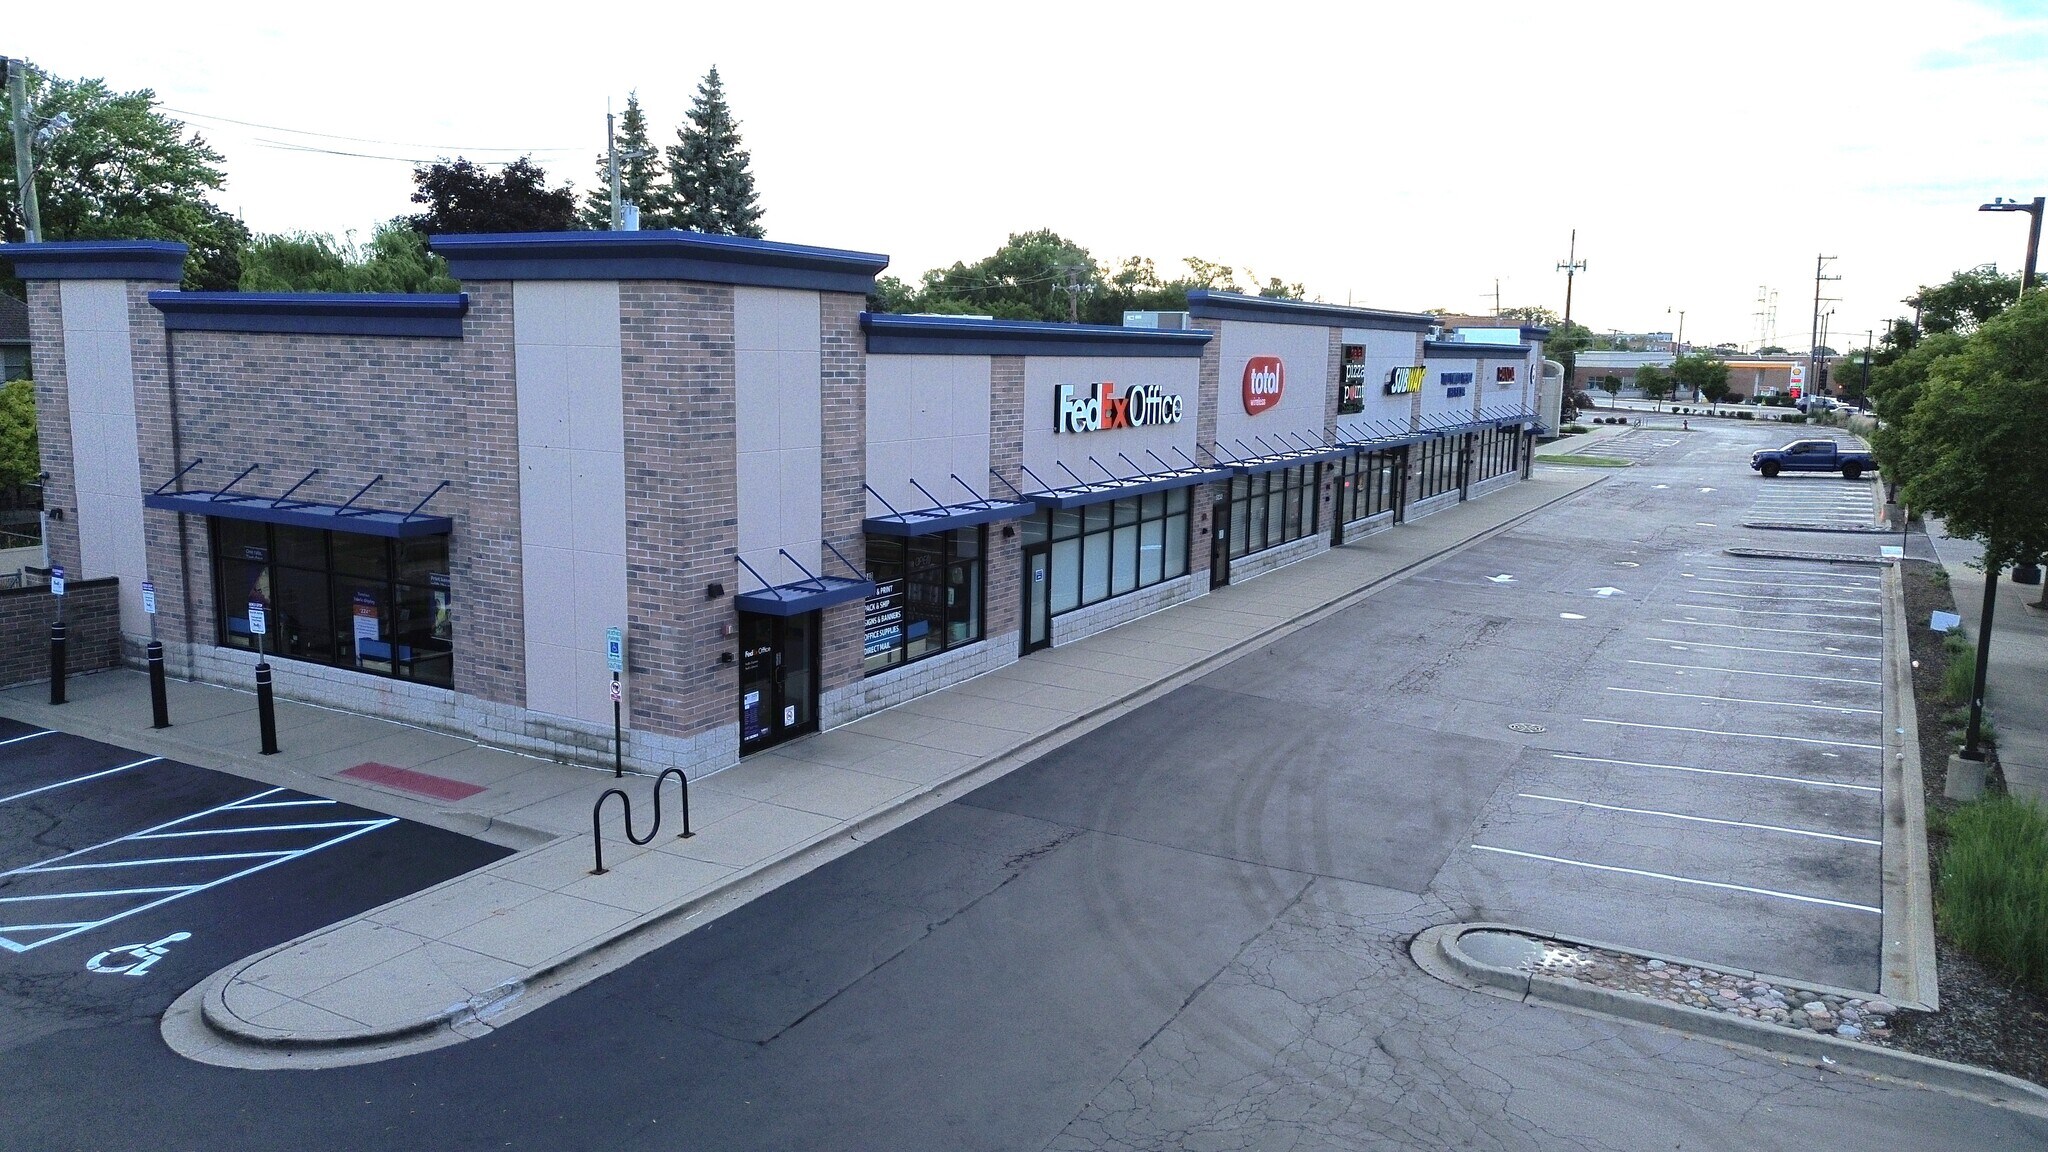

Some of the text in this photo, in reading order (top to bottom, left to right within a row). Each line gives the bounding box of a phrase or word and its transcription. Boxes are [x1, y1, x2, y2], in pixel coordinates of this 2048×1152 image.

[1251, 362, 1280, 394] total
[1391, 366, 1426, 393] SUBWAY
[1055, 383, 1183, 433] FedEx Office
[880, 585, 893, 594] PRINT
[880, 600, 890, 609] SHIP
[881, 611, 902, 622] BANNERS
[864, 625, 899, 640] OFFICE SUPPLIES
[864, 641, 891, 655] DIRECT MAIL
